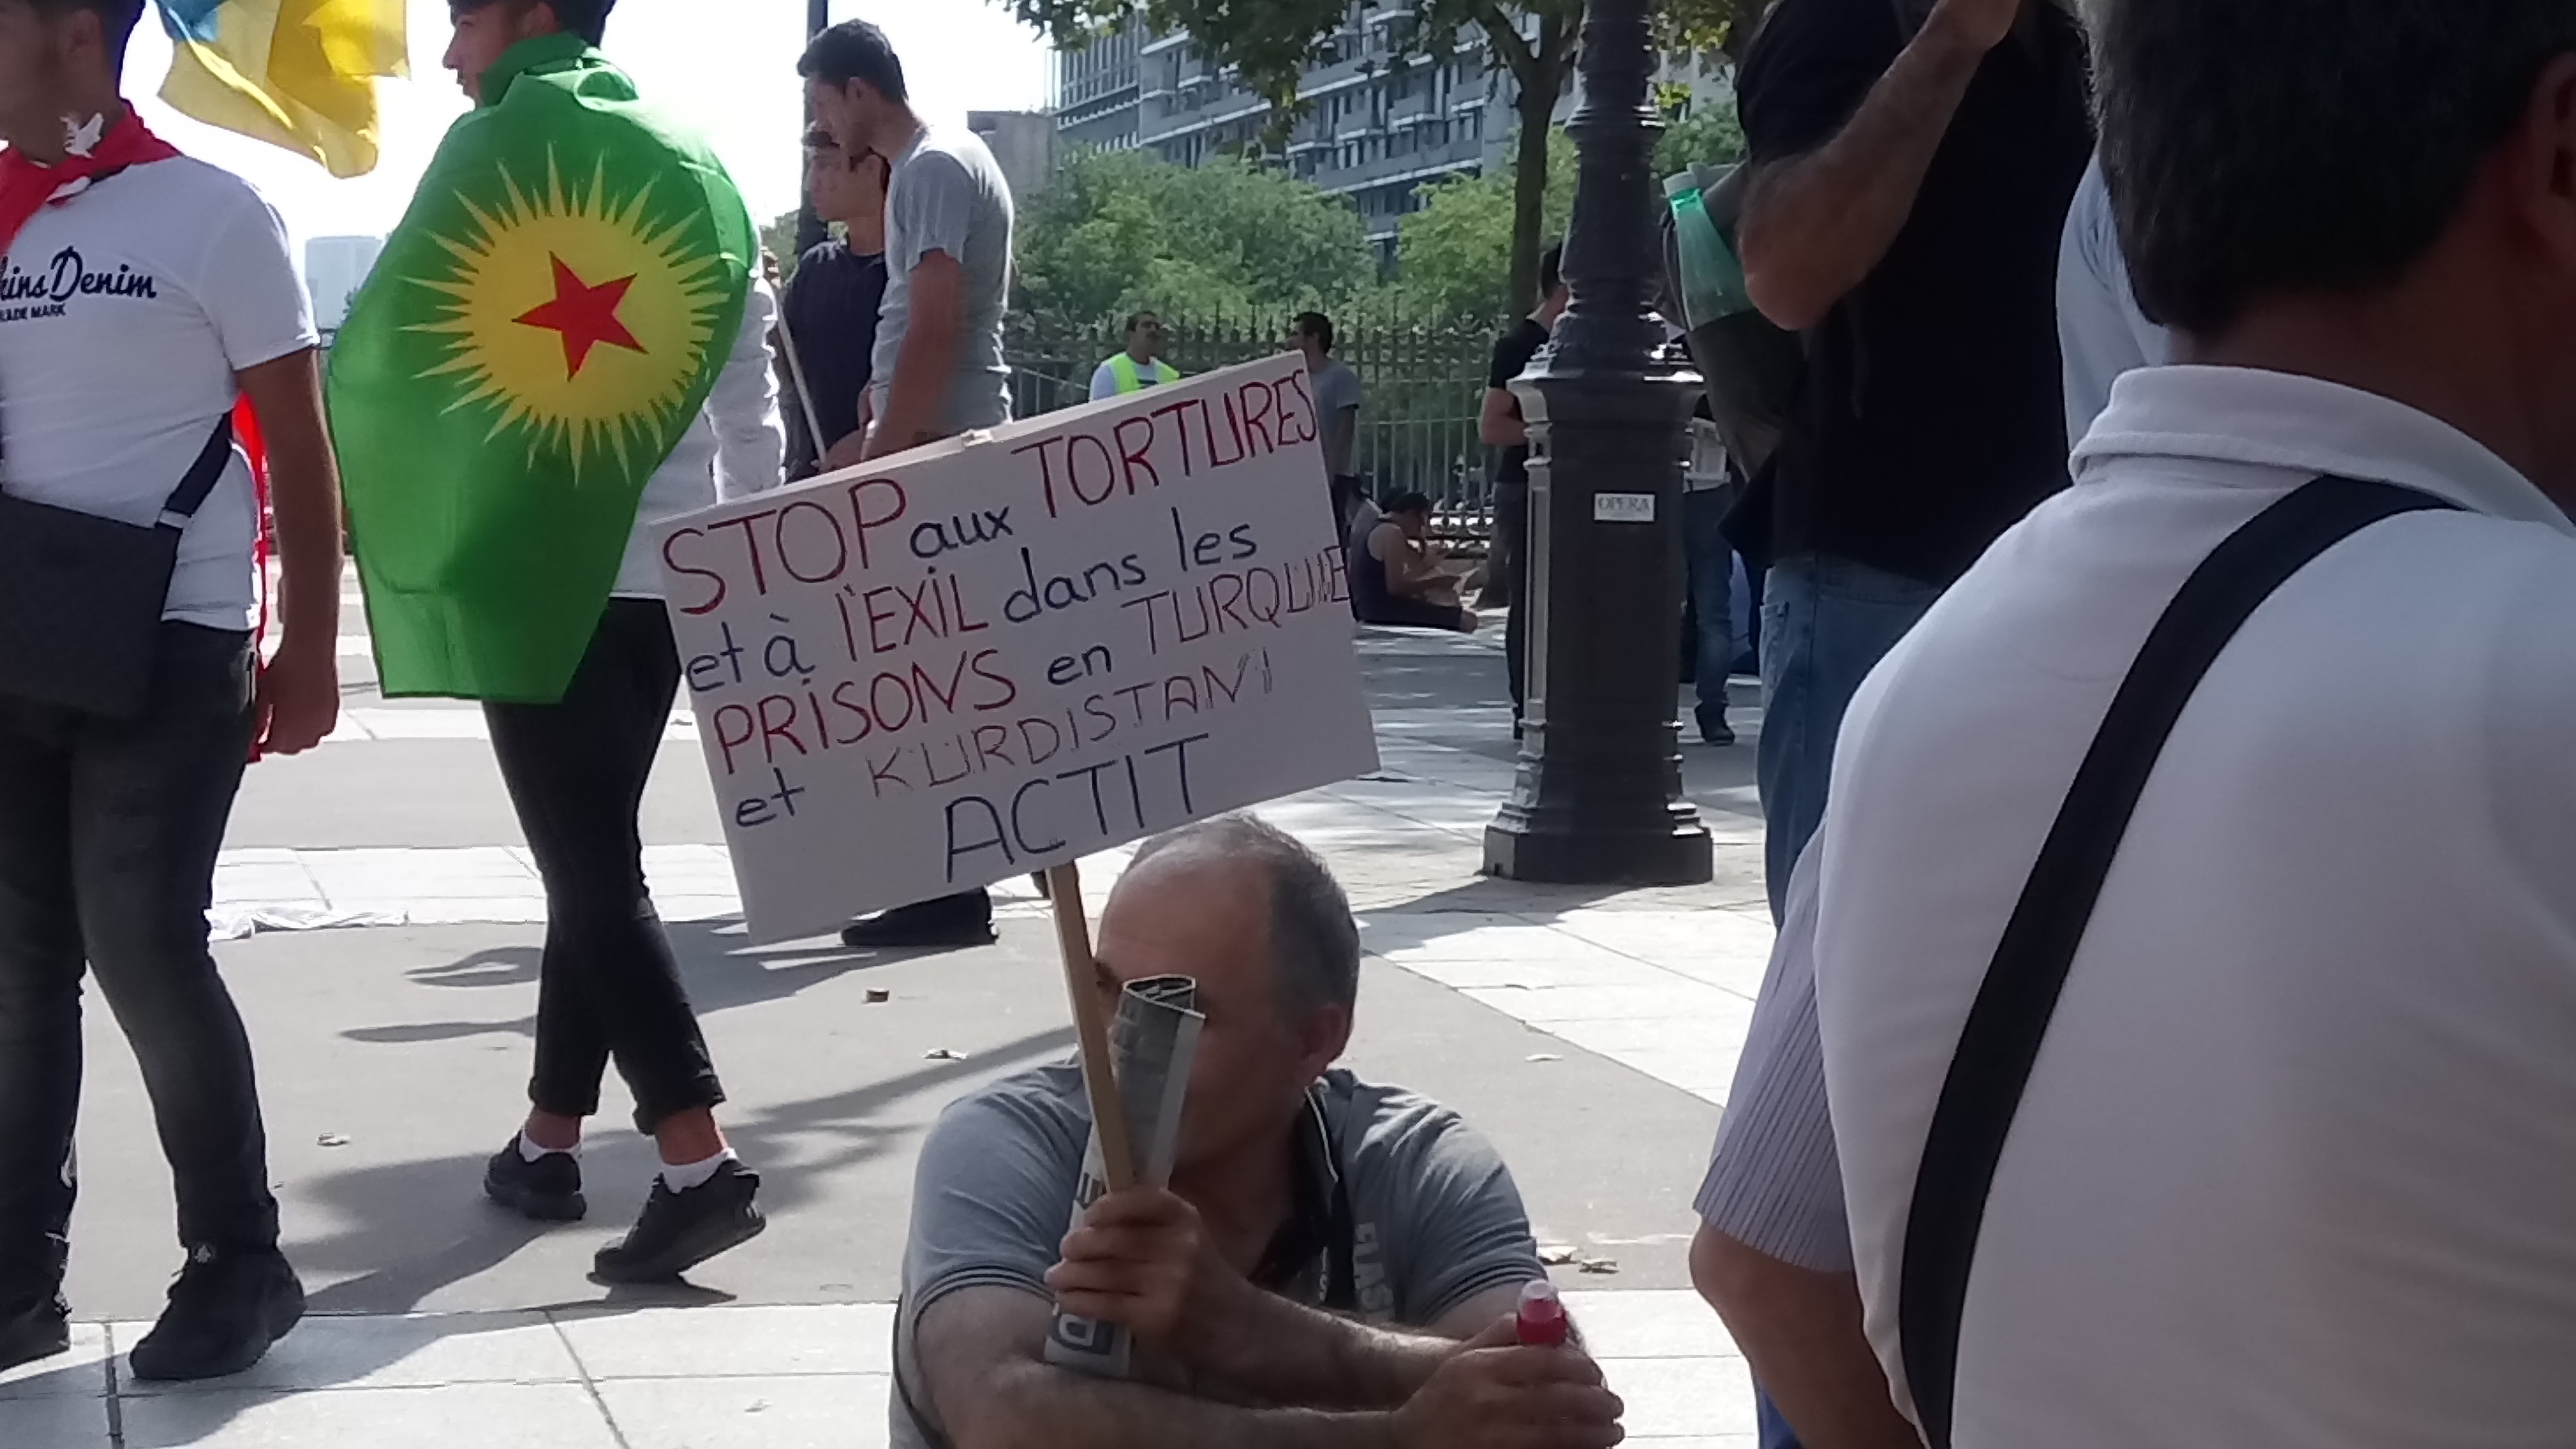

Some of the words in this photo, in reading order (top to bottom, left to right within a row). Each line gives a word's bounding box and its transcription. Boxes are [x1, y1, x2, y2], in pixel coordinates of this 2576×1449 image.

[31, 303, 66, 318] MARK
[50, 245, 157, 302] Denim
[663, 479, 906, 614] STOP
[909, 506, 1013, 558] aux
[1010, 369, 1318, 518] TORTURES
[686, 621, 745, 692] et
[763, 613, 816, 677] à
[1003, 547, 1147, 623] dans
[1171, 506, 1257, 572] les
[713, 649, 1017, 775] PRISONS
[1046, 644, 1112, 686] en
[1120, 545, 1351, 655] TURQUIE
[736, 767, 806, 828] et
[945, 732, 1209, 884] ACTIT
